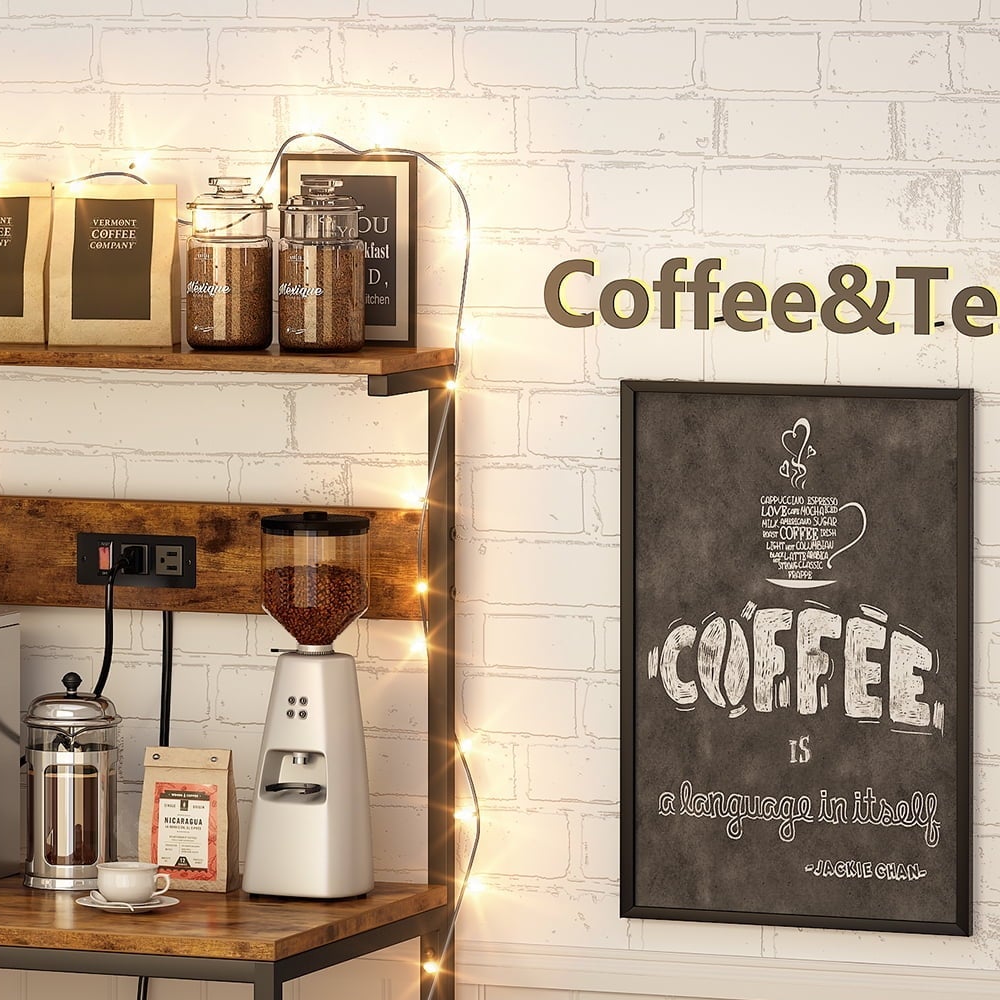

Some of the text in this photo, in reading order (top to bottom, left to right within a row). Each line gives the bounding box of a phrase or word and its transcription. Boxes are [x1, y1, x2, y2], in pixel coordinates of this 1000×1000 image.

[93, 219, 137, 227] VERMONT
[91, 229, 136, 239] COFFEE
[89, 241, 136, 250] COMPANY
[365, 242, 390, 259] kfast
[365, 294, 390, 305] itchen
[760, 496, 805, 505] CAPPUCCINO
[761, 505, 787, 517] LOVE
[800, 505, 825, 516] MOCHA
[761, 519, 780, 529] MILK
[813, 516, 838, 527] SUGAR
[780, 526, 819, 541] COFFEE
[784, 552, 807, 561] LATTE
[659, 607, 933, 727] COFFEE
[788, 735, 813, 764] IS
[658, 791, 675, 816] a
[679, 780, 814, 842] language
[818, 790, 848, 825] in
[164, 817, 203, 826] NICARAGUA
